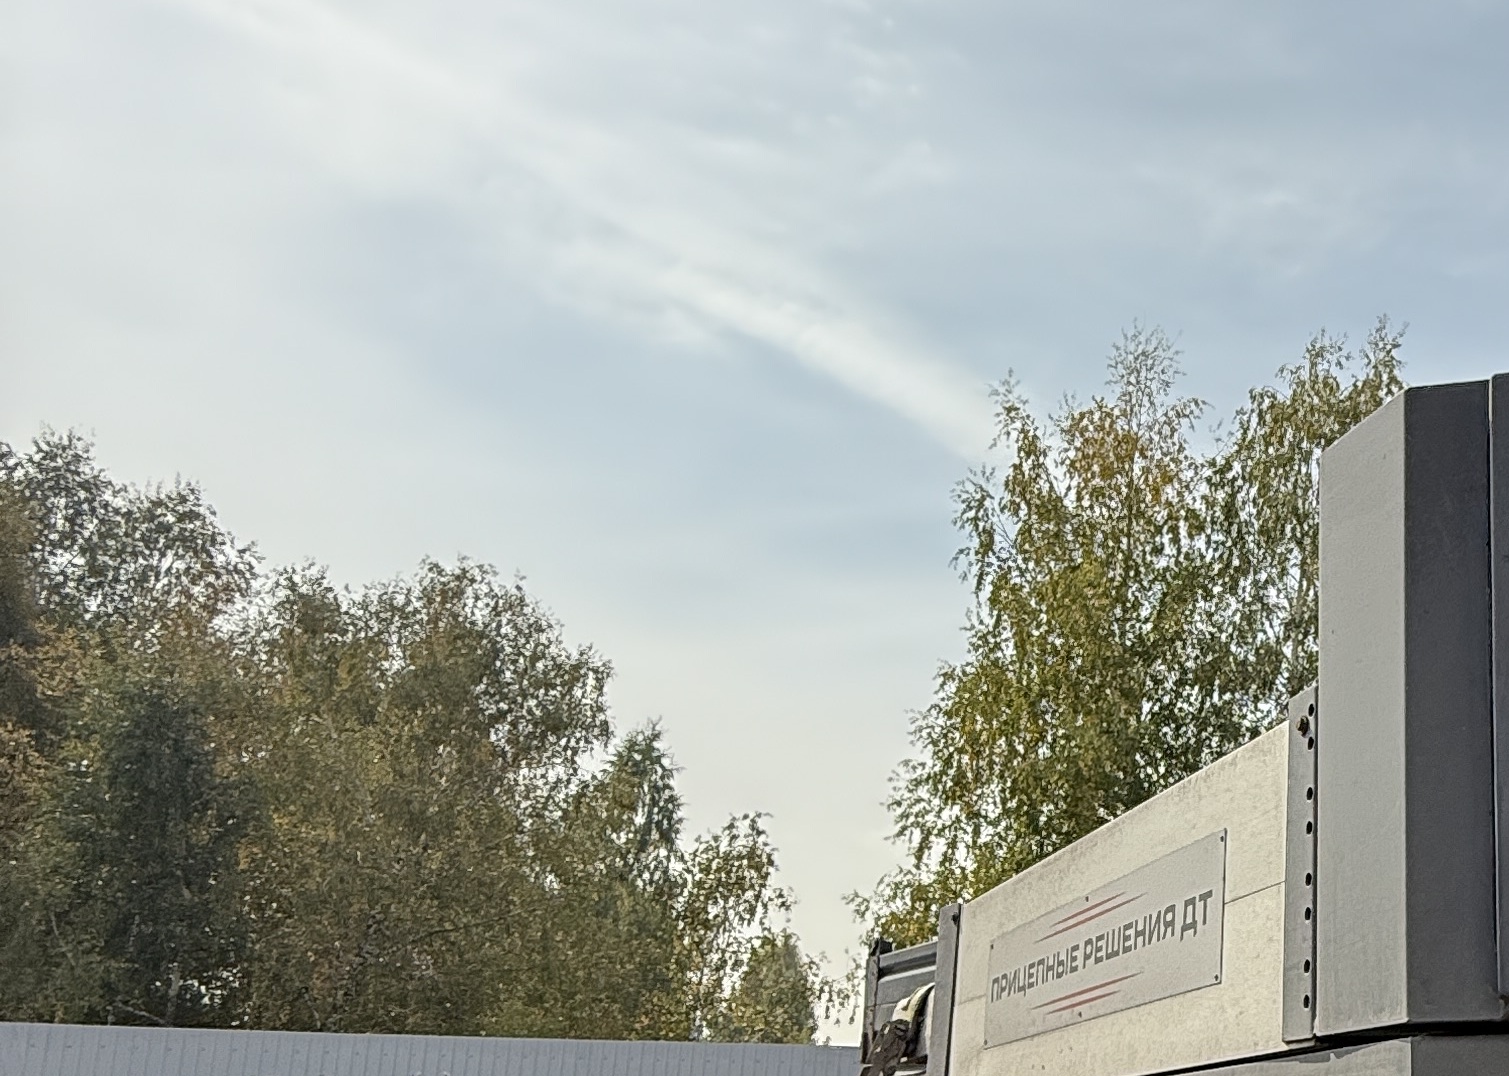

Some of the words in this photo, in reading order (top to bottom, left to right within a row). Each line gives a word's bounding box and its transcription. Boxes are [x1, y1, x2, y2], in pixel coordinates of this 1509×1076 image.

[990, 944, 1080, 1003] ПРИЦЕПНЫЕ
[1082, 903, 1177, 970] РЕШЕНИЯ
[1180, 889, 1214, 942] ДТ
